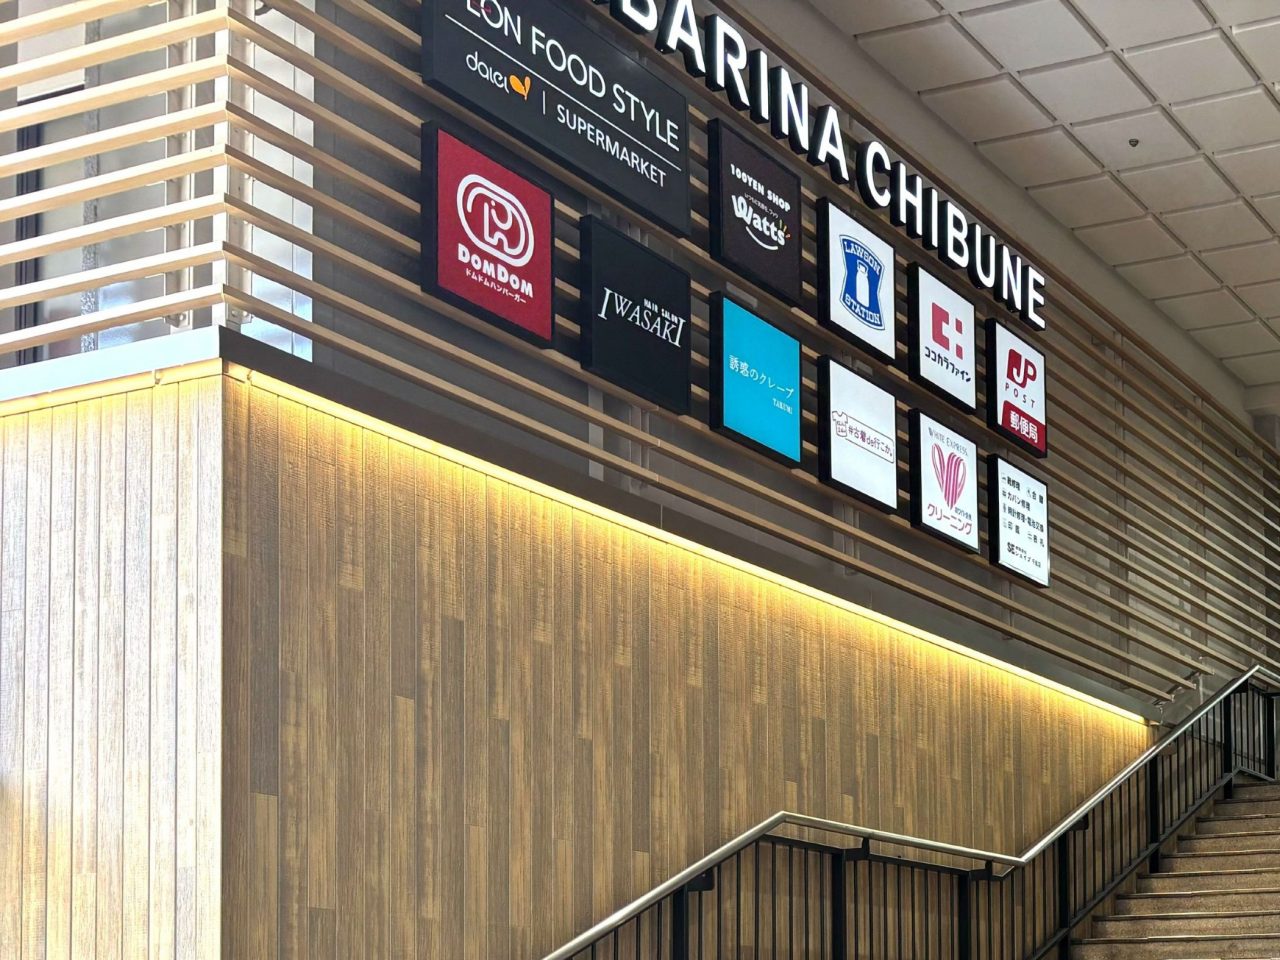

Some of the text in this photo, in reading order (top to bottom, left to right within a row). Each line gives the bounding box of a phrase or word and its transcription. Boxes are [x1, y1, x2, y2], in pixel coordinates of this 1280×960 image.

[532, 25, 606, 98] FOOD
[613, 83, 680, 152] STYLE
[556, 104, 666, 188] SUPERMARKET
[730, 163, 765, 196] 100YEN
[767, 189, 791, 212] SHOP
[731, 195, 786, 246] Watts
[865, 141, 1046, 329] CHIBUNE
[457, 243, 534, 298] DOMDOM
[843, 241, 881, 276] LAWSON
[465, 267, 527, 304] ドムドムハンバーガー
[597, 287, 686, 348] IWASAKI
[844, 293, 881, 324] STATION
[924, 346, 971, 383] ココカラファイン
[1005, 382, 1035, 408] POST
[1010, 410, 1038, 443] 郵便局
[927, 503, 972, 535] クリーニング
